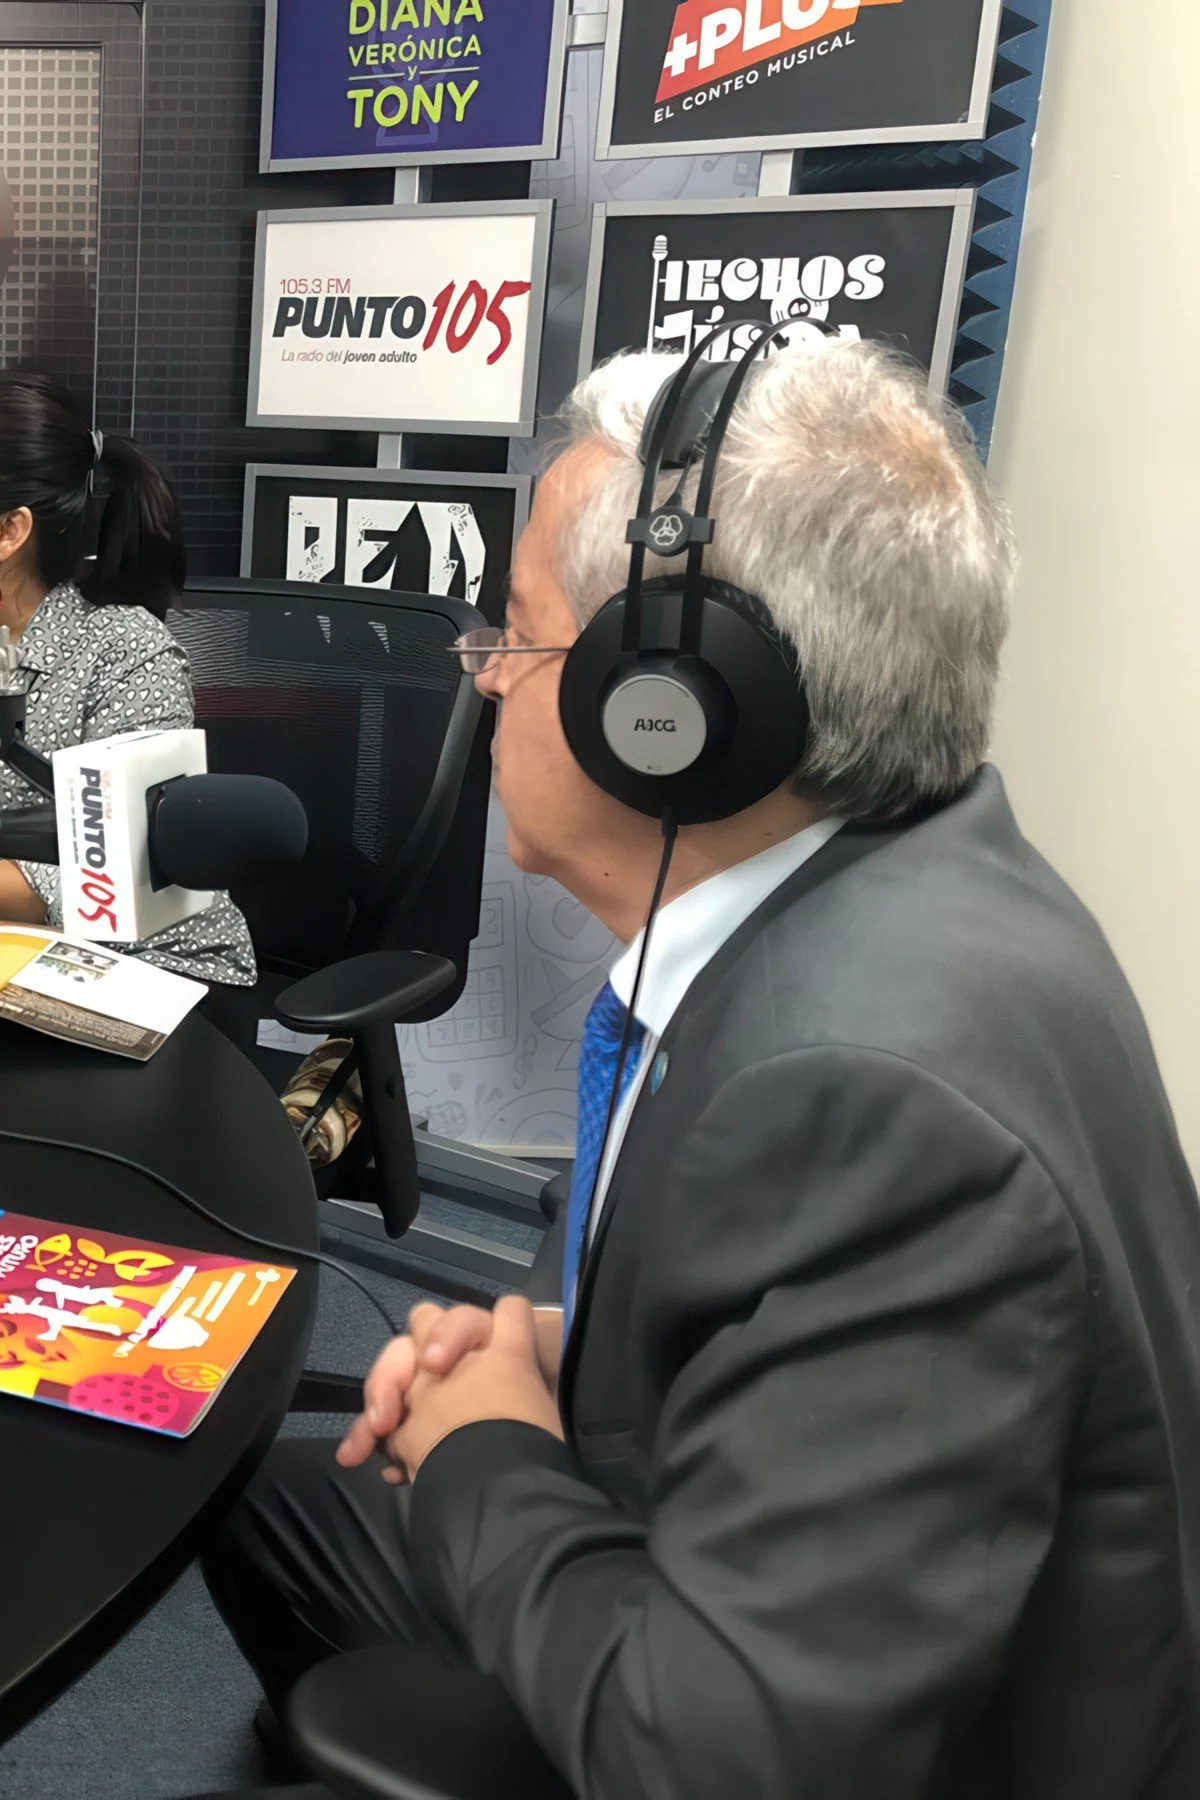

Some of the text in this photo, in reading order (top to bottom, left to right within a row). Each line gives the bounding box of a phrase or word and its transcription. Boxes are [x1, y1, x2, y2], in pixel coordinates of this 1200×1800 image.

[349, 0, 484, 35] DIANA
[349, 34, 482, 67] VERÓNICA
[653, 31, 856, 124] EL CONTEO MUSICAL
[347, 79, 479, 128] TONY
[279, 278, 351, 294] 105.3 FM
[648, 254, 886, 302] HECHOS
[272, 279, 532, 366] PUNTO 105
[342, 350, 376, 365] joven
[378, 350, 418, 363] adulto
[77, 766, 118, 933] PUNTO 105
